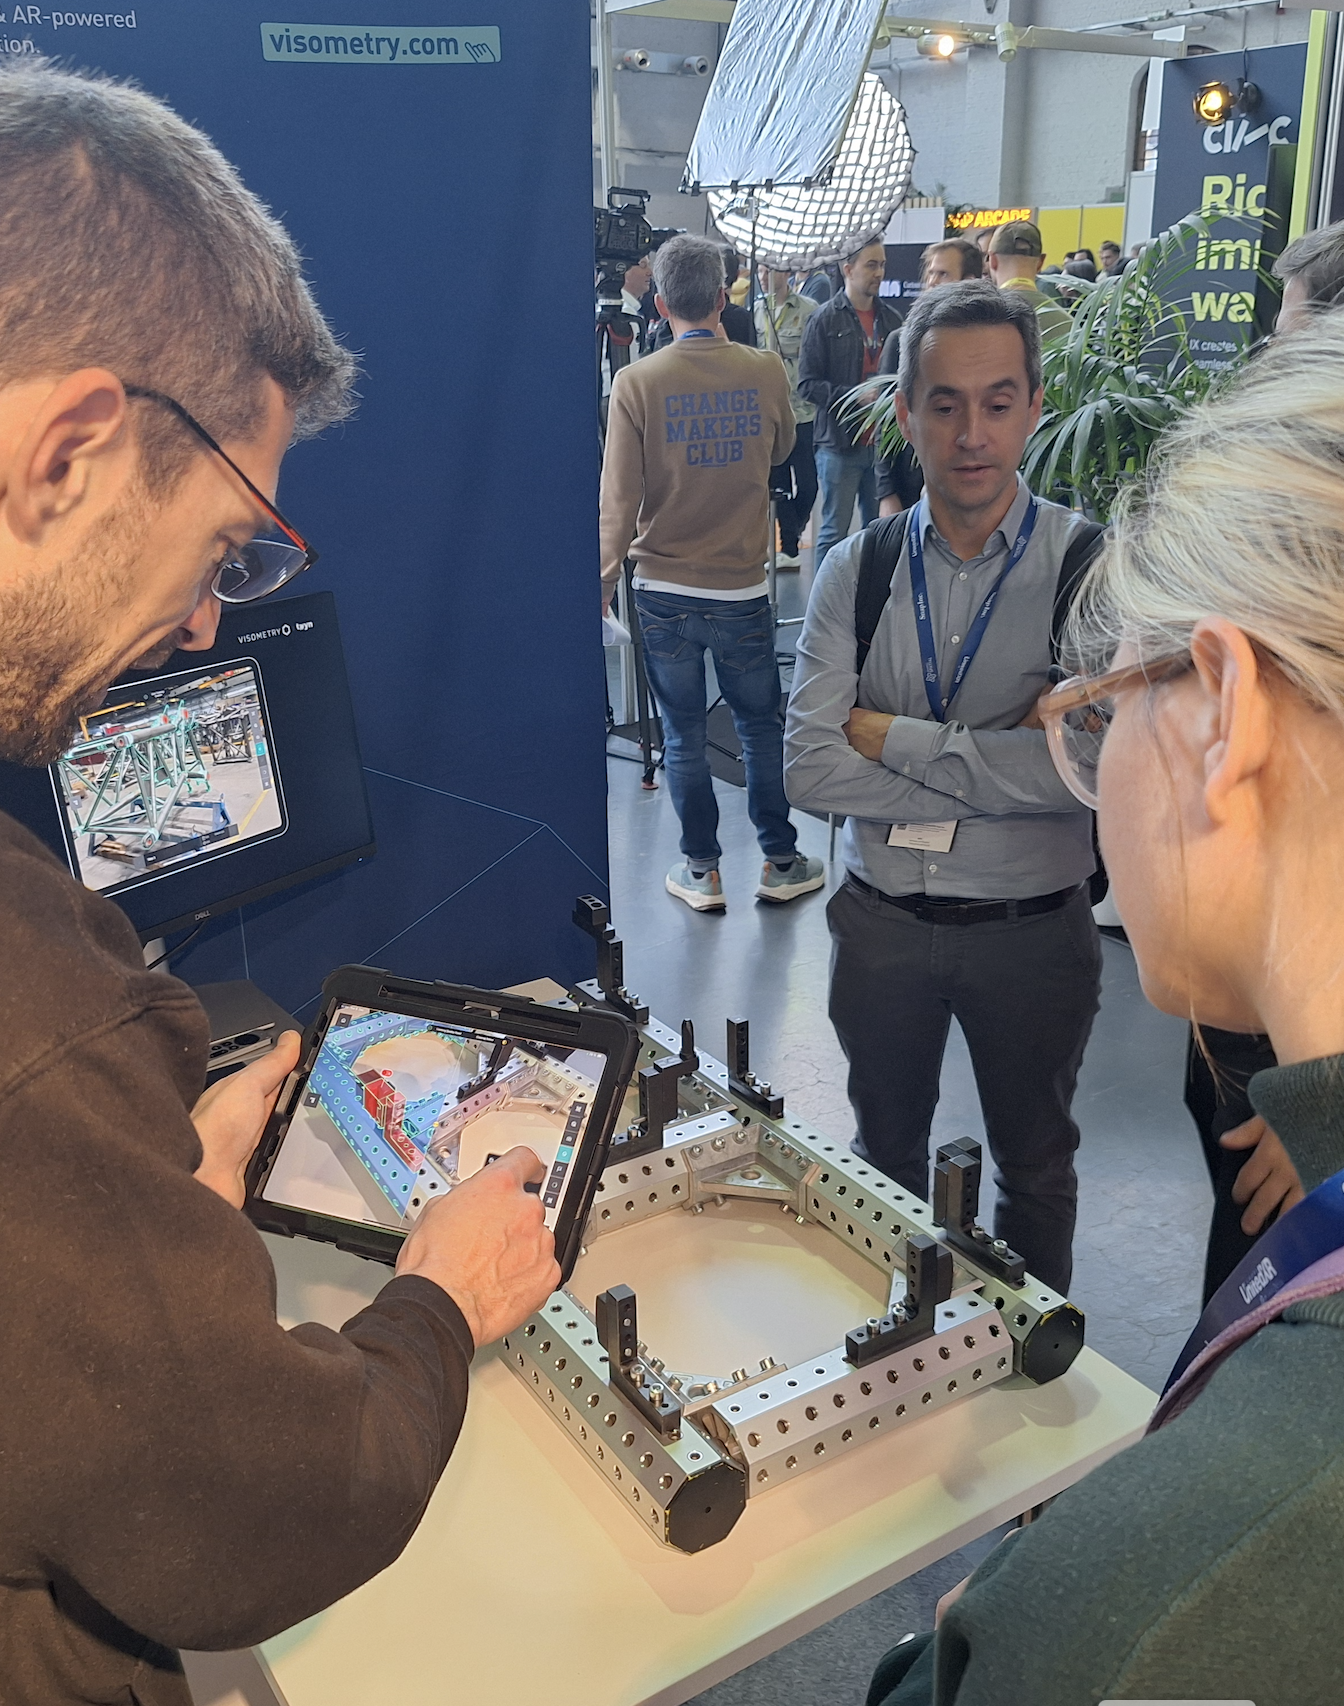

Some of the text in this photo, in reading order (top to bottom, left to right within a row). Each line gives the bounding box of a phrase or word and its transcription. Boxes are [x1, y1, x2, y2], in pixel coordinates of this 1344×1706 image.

[13, 4, 137, 30] AR-powered
[269, 28, 459, 60] visometry.com
[973, 208, 1032, 228] ARCADE
[665, 389, 759, 418] CHANGE
[665, 414, 761, 443] MAKERS
[686, 440, 744, 466] CLUB
[238, 627, 282, 644] VISOMETRY
